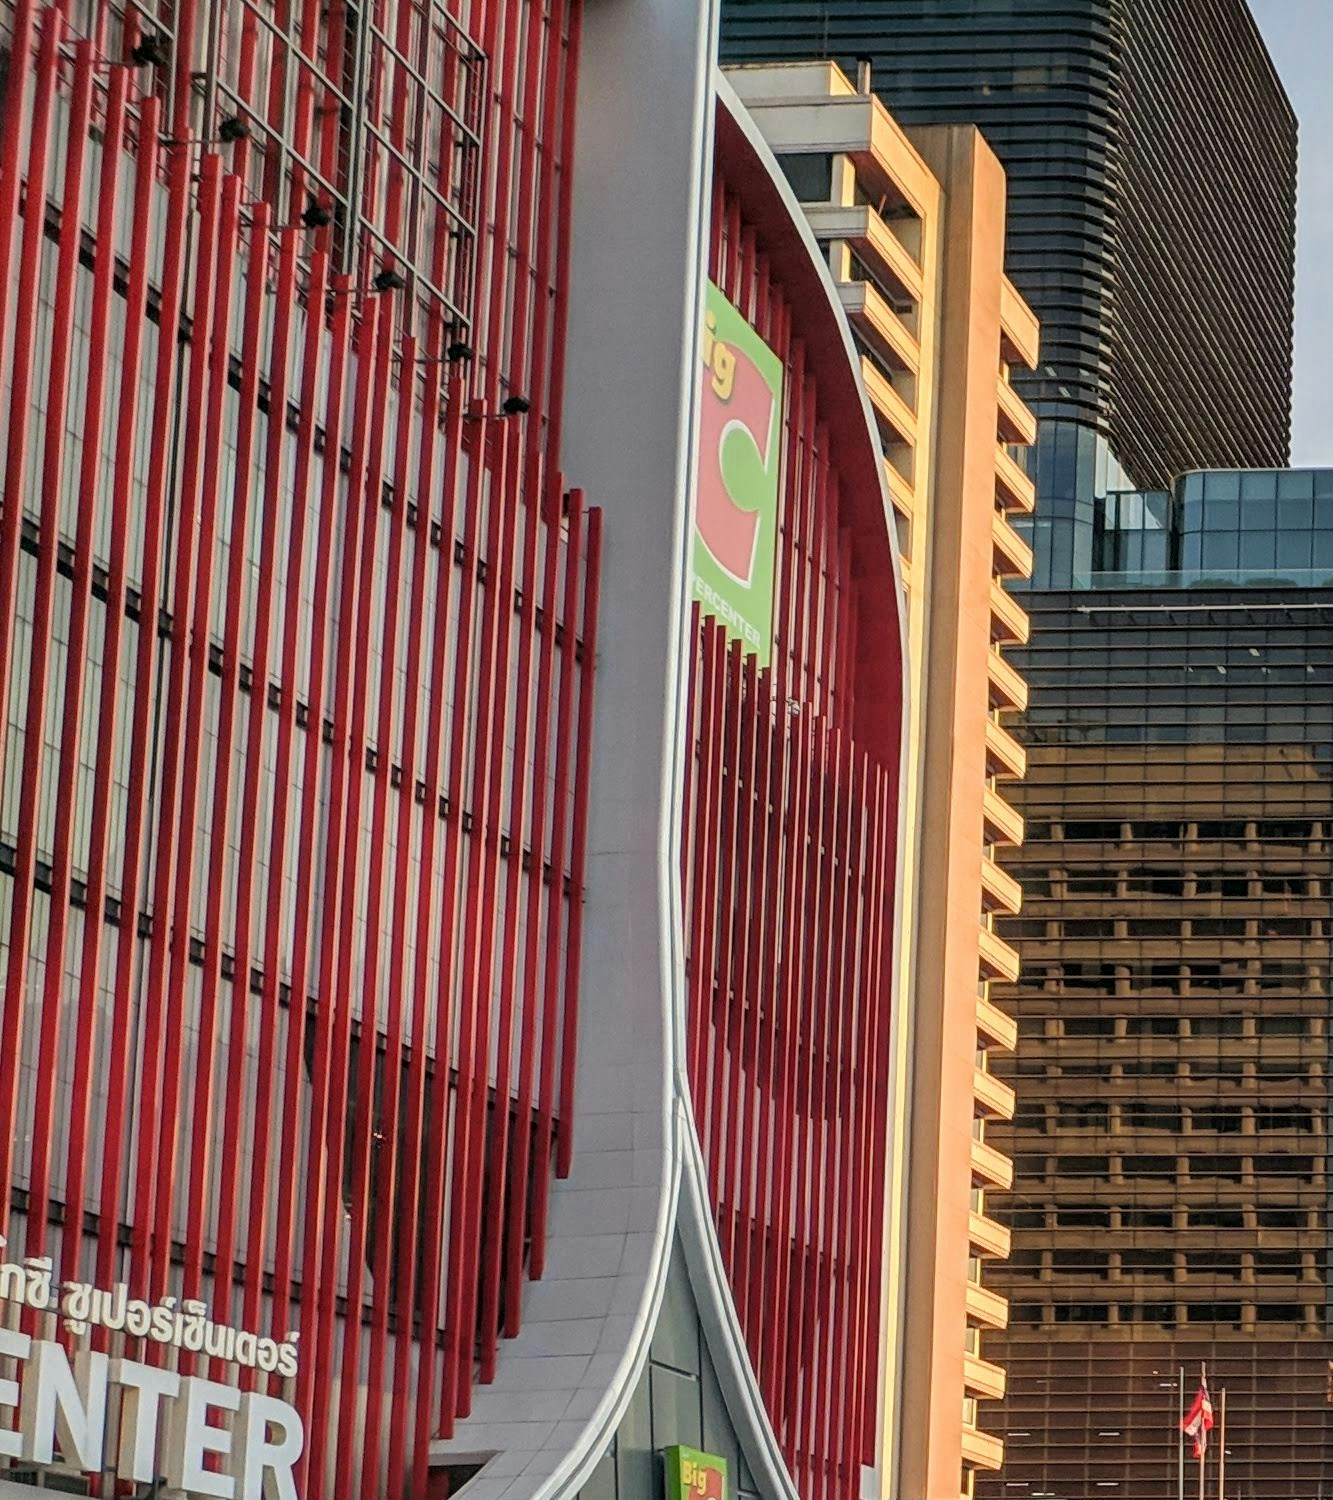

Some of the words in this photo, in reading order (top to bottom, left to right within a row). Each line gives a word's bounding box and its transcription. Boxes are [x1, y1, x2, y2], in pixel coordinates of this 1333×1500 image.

[702, 309, 736, 400] ig
[690, 572, 762, 650] ERCENTER
[0, 1240, 53, 1309] กซี
[62, 1280, 300, 1378] ซูเปอร์เซ็นเตอร์
[682, 1460, 708, 1496] Big
